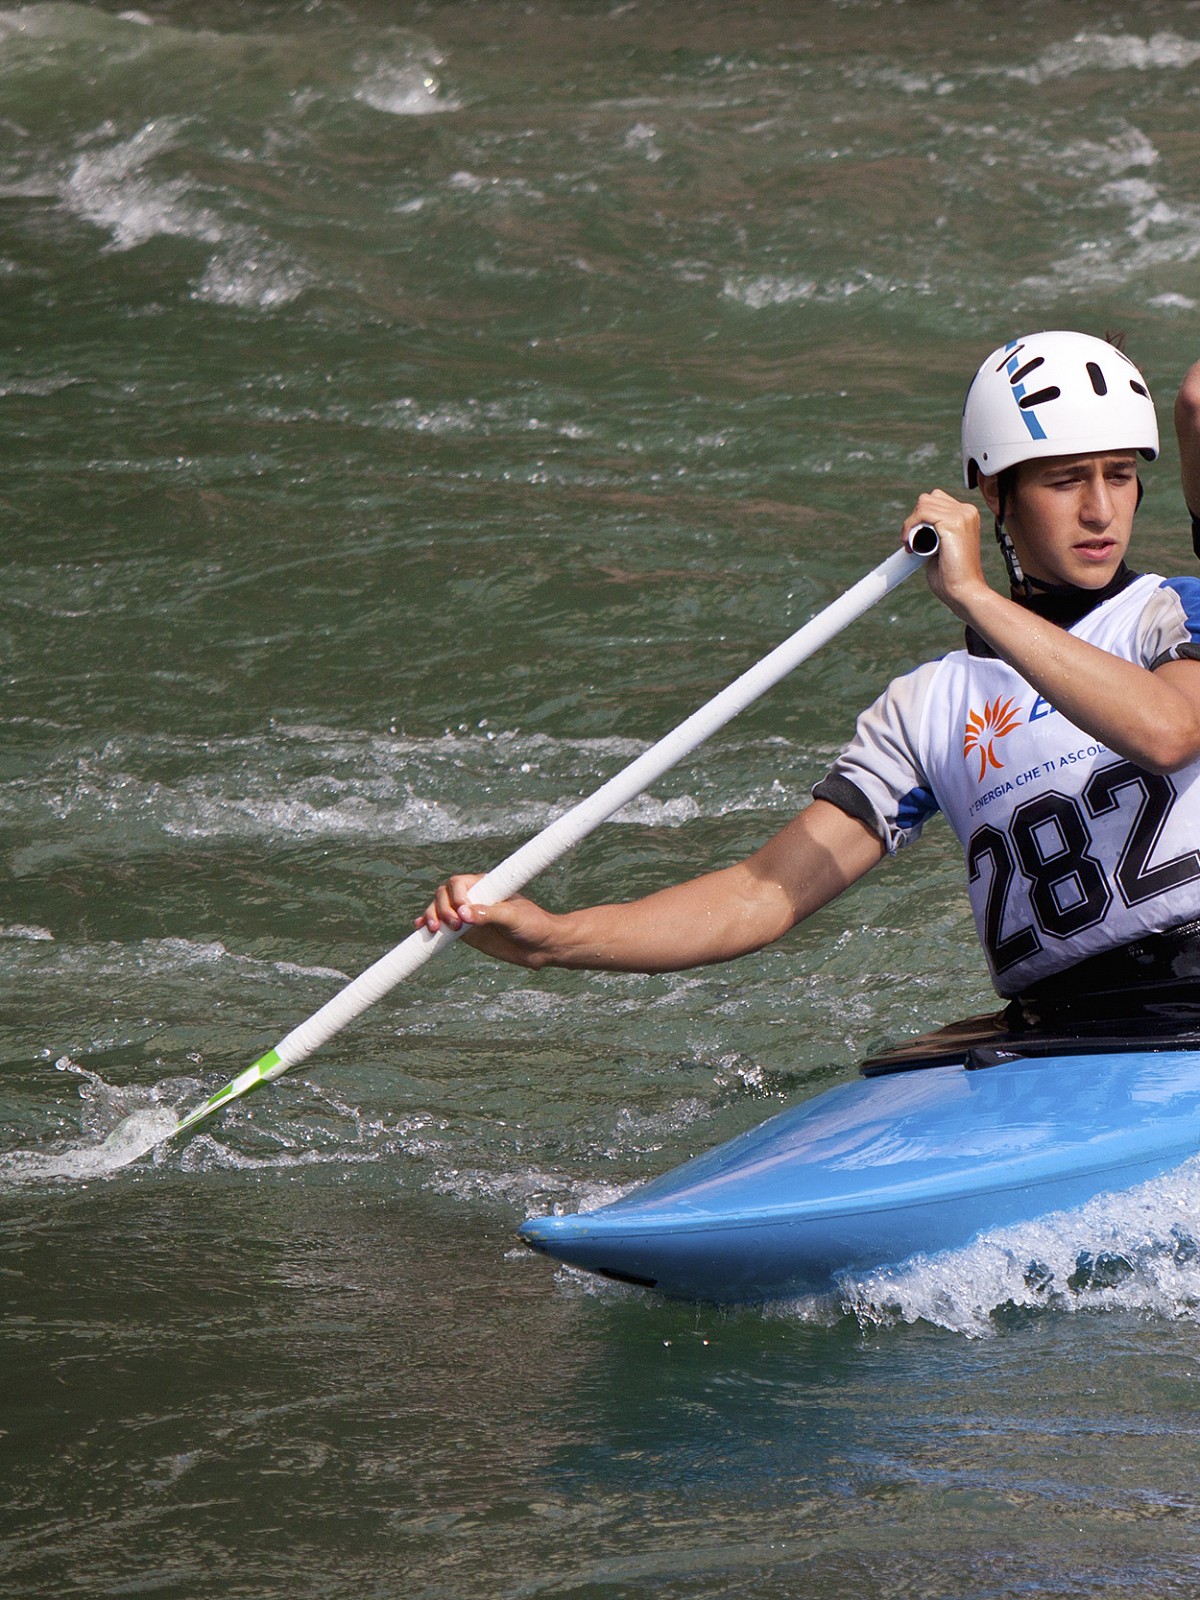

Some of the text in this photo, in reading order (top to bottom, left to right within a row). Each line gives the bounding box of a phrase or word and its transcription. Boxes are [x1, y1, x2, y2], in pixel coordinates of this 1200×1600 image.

[1015, 767, 1041, 786] CHE
[1043, 761, 1056, 773] TI
[1060, 744, 1107, 768] ASCOL
